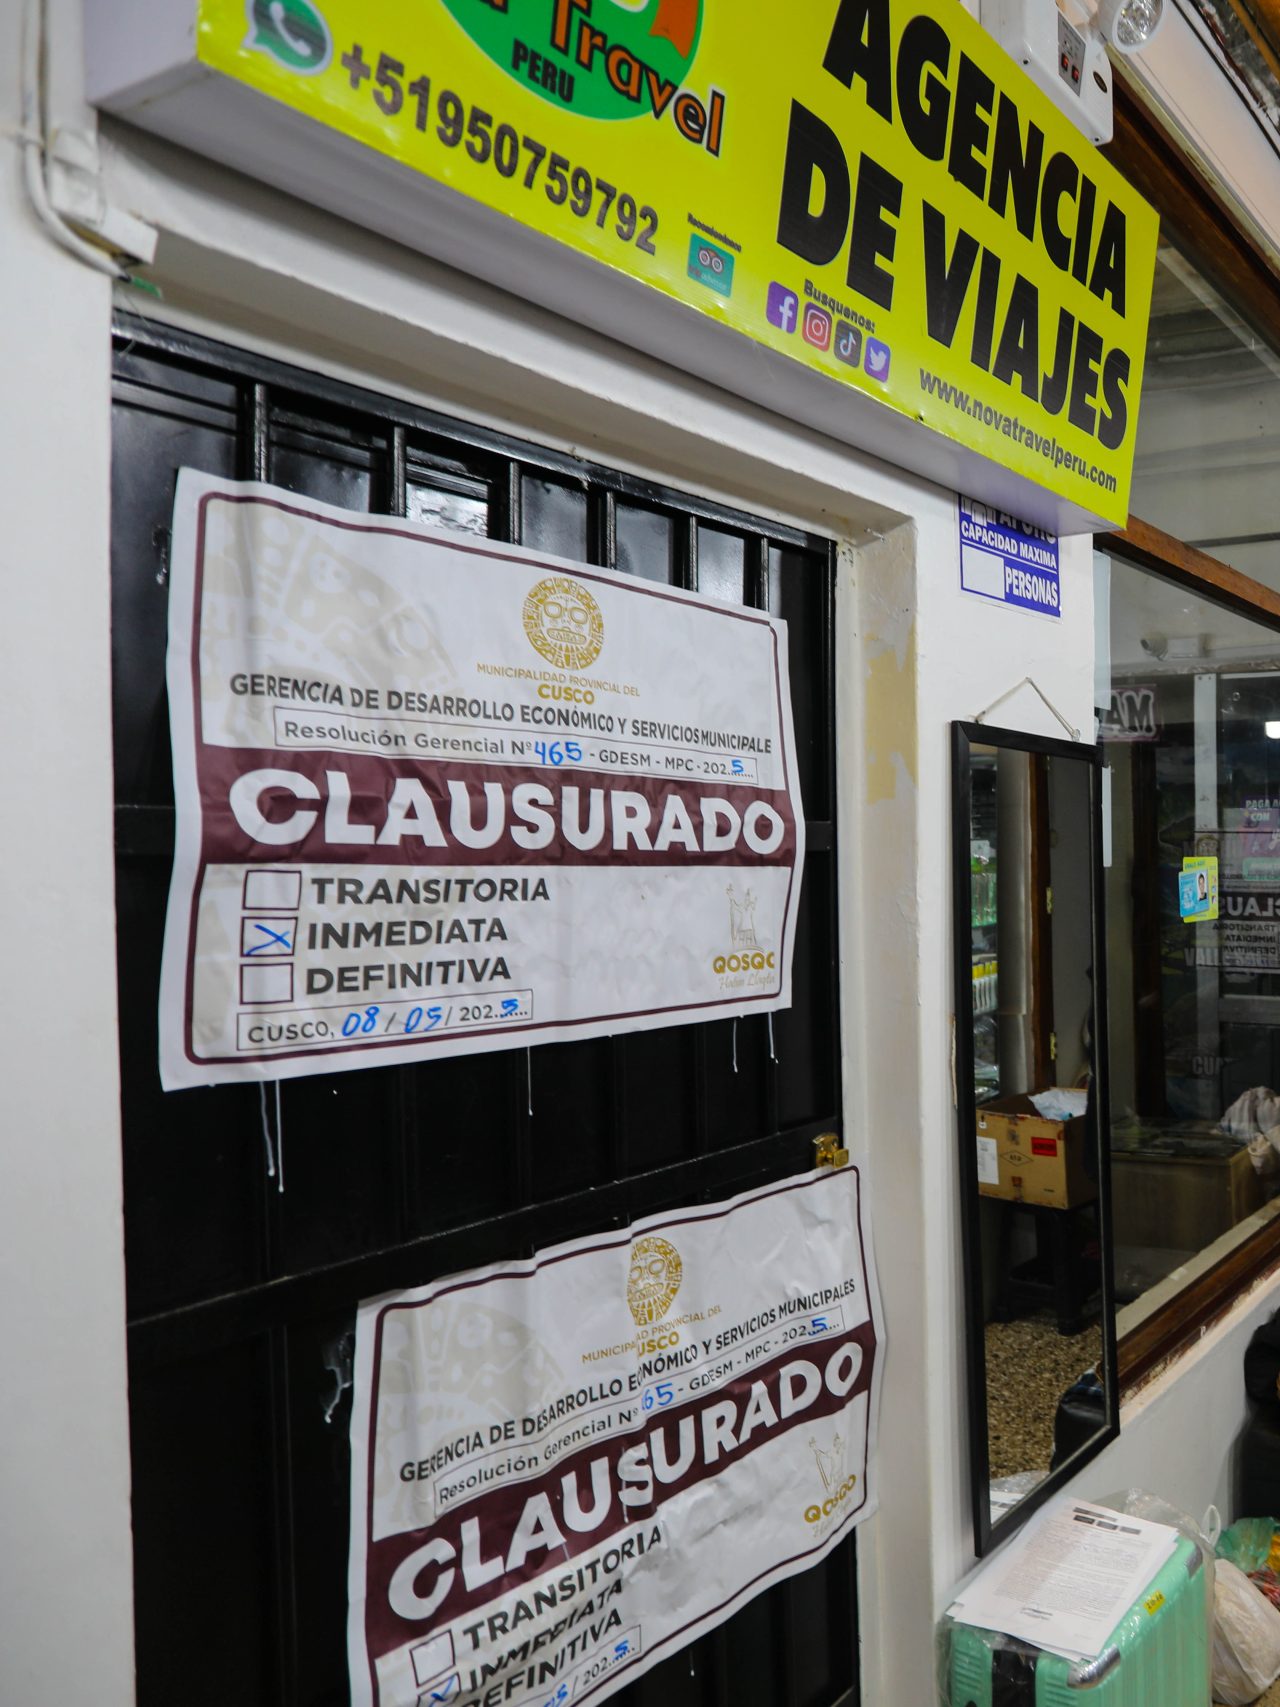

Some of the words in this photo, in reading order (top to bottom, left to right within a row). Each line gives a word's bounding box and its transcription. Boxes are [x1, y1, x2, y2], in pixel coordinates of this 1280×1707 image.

[511, 37, 576, 103] PERU
[340, 44, 659, 256] +51950759792
[822, 0, 1127, 319] AGENCIA
[776, 97, 904, 312] DE
[803, 278, 876, 334] Busquenos:
[922, 198, 1131, 451] VIAJES
[919, 366, 1117, 494] www.novatravelperu.com
[961, 520, 1018, 555] CAPACIDAD
[1019, 541, 1057, 569] MAXIMA
[1004, 566, 1059, 608] PERSONAS
[230, 673, 344, 706] GERENCIA
[349, 687, 380, 710] DE
[386, 690, 515, 723] DESARROLLO
[520, 702, 614, 733] ECONÓMICO
[617, 717, 628, 735] Y
[631, 720, 700, 745] SERVICIOS
[477, 663, 567, 684] MUNICIPALIDAD
[568, 674, 621, 695] PROVINCIAL
[623, 685, 640, 697] DEL
[537, 683, 596, 705] CUSCO
[284, 721, 407, 747] Resolución
[413, 731, 505, 755] Gerencial
[599, 750, 651, 768] GDESM
[665, 756, 694, 772] MPC
[229, 768, 785, 857] CLAUSURADO
[310, 877, 551, 905] TRANSITORIA
[307, 917, 509, 950] INMEDIATA
[305, 956, 512, 996] DEFINITIVA
[634, 1331, 681, 1358] USCO
[650, 1313, 707, 1342] PROVINCIAL
[707, 1304, 722, 1318] DEL
[399, 1430, 485, 1483] GERENCIA
[488, 1420, 516, 1445] DE
[521, 1378, 624, 1438] DESARROLLO
[702, 1338, 712, 1355] Y
[714, 1314, 777, 1351] SERVICIOS
[778, 1278, 856, 1320] MUNICIPALES
[438, 1455, 540, 1506] Resolución
[543, 1415, 612, 1462] Gerencial
[688, 1362, 734, 1391] GDESM
[744, 1342, 772, 1365] MPC
[387, 1341, 864, 1621] CLAUSURADO
[462, 1525, 662, 1651] TRANSITORIA
[468, 1578, 623, 1694] INMEDIATA
